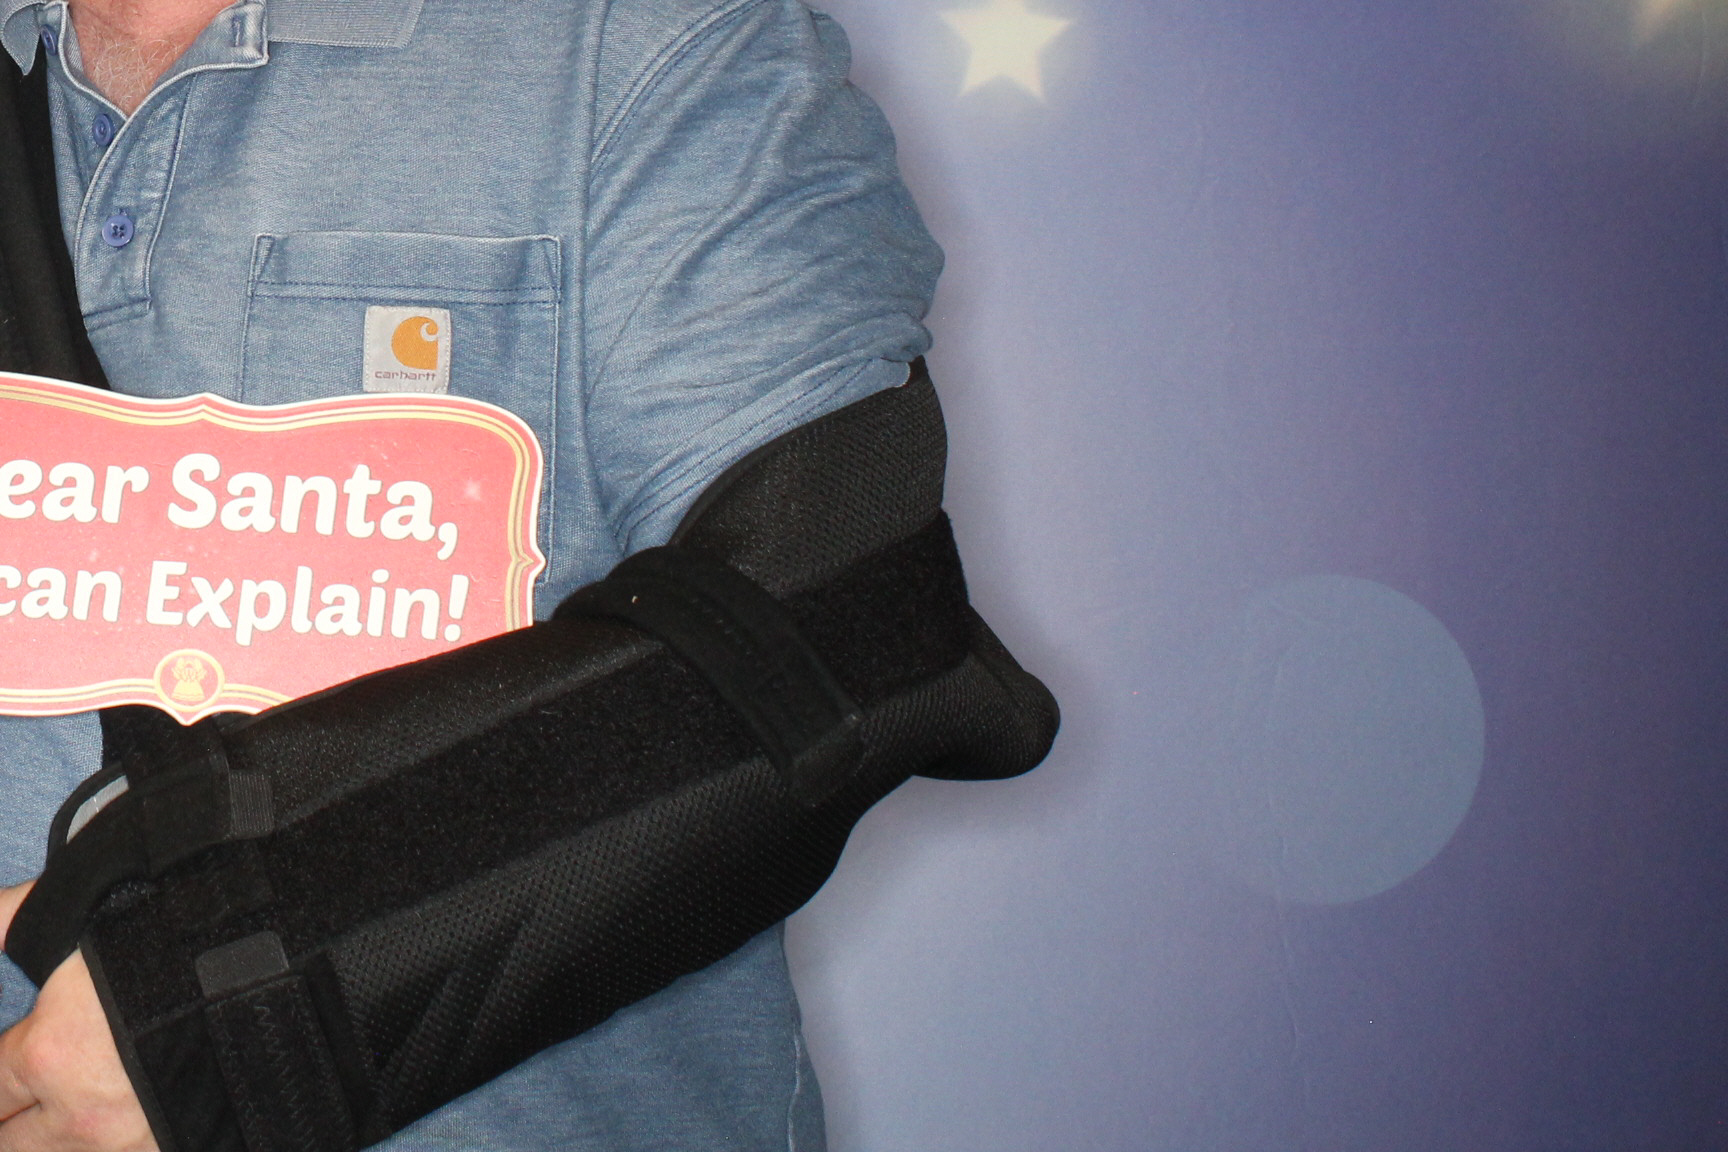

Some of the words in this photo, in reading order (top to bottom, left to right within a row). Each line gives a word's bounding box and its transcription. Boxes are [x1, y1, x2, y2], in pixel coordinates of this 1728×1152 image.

[374, 370, 436, 381] carhartt
[167, 453, 459, 560] Santa,
[145, 560, 470, 646] Explain!
